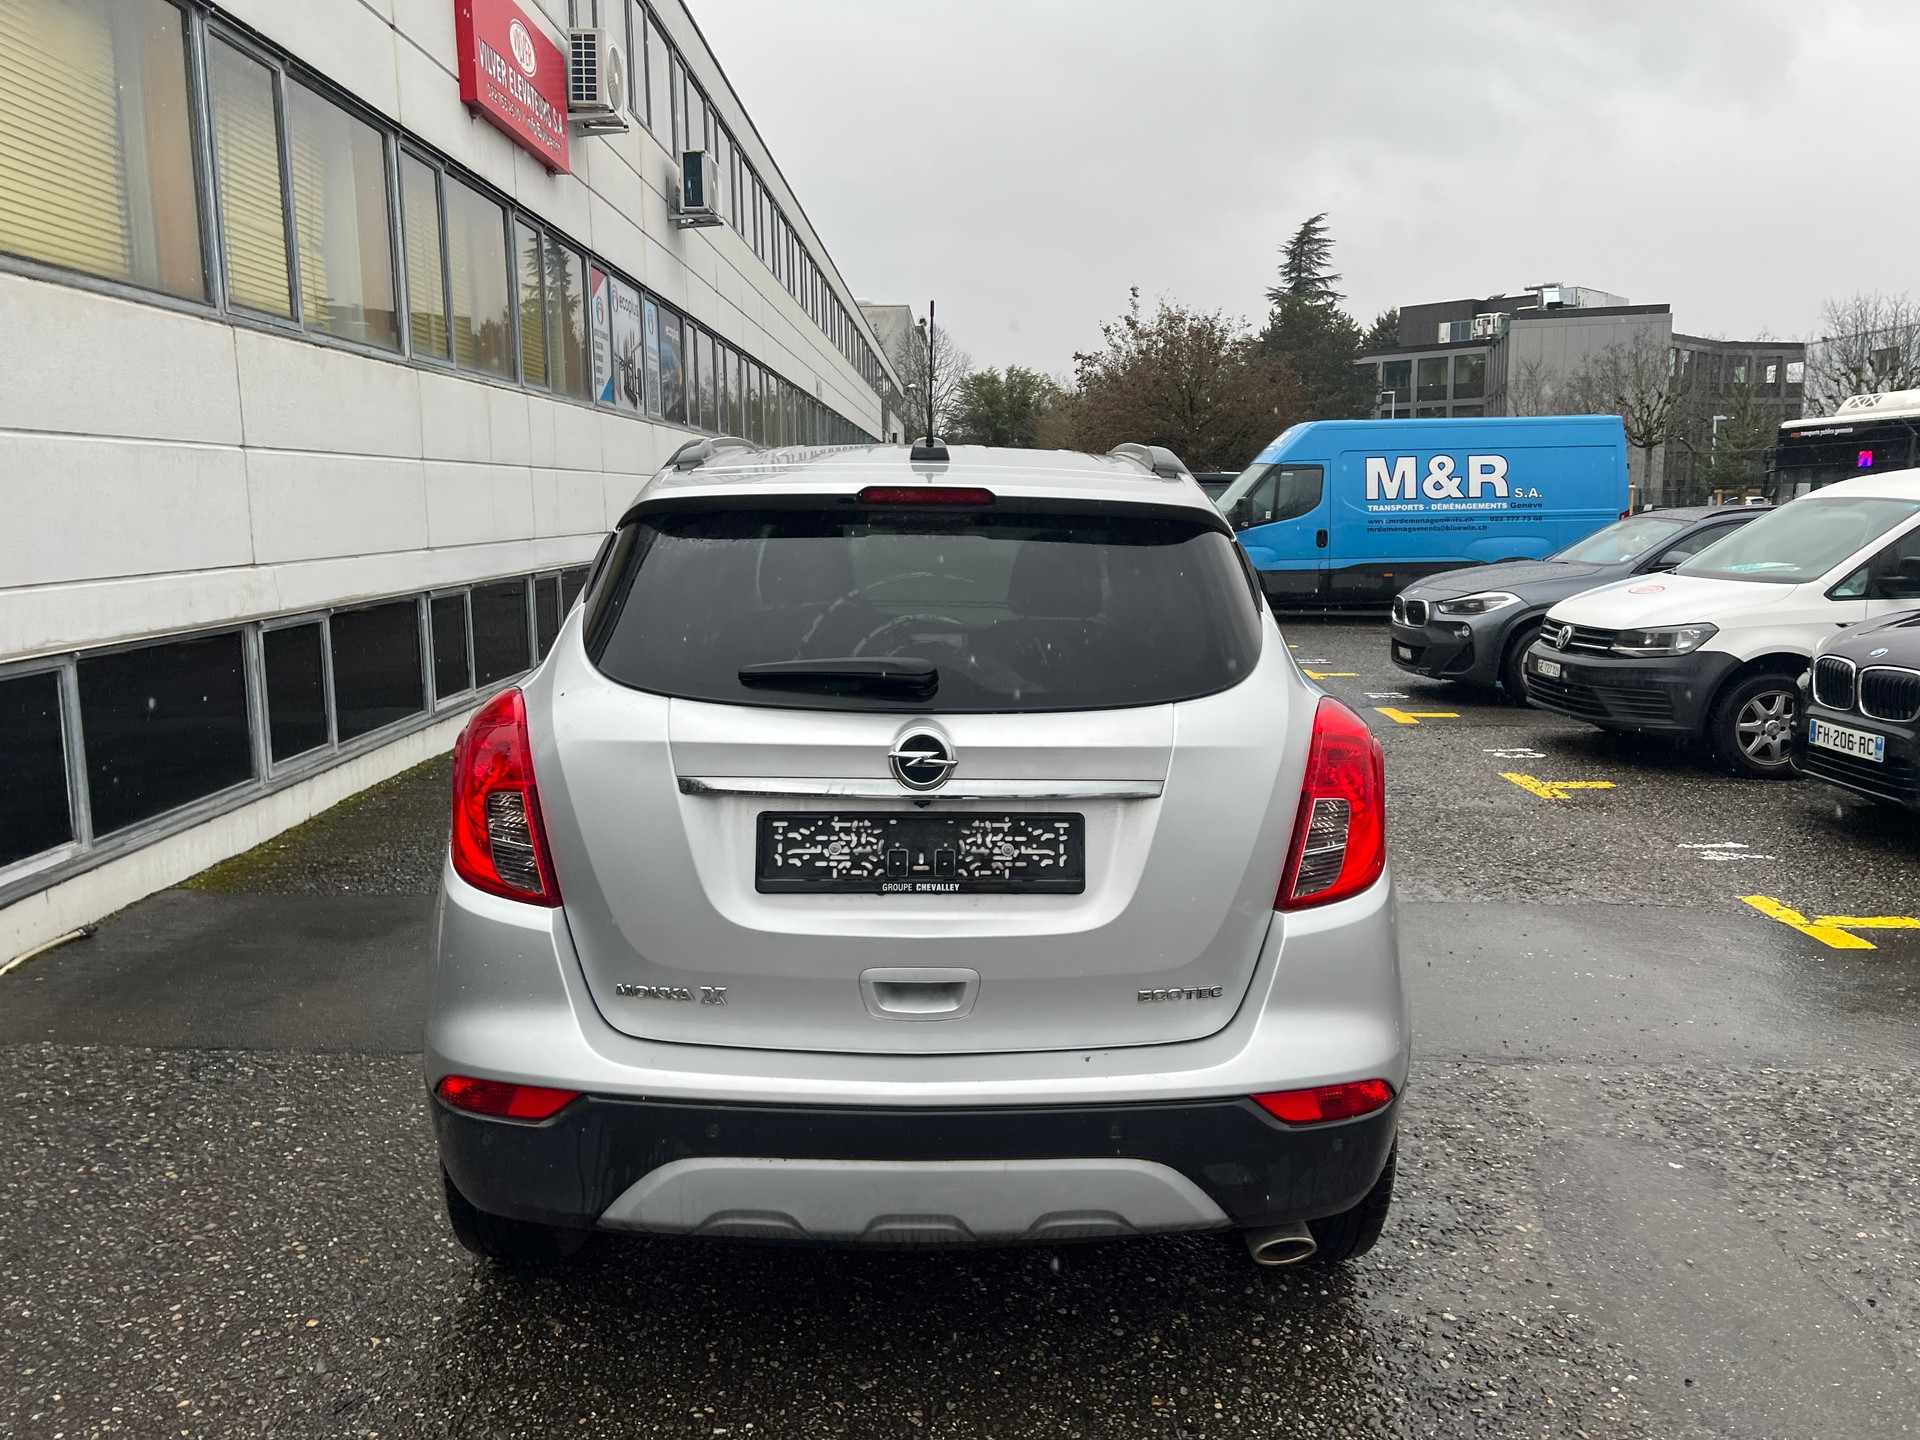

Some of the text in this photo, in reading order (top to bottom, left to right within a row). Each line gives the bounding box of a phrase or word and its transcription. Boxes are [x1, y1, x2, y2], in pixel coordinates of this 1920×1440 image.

[478, 35, 508, 89] VILVER
[619, 294, 639, 319] ecoplus
[1365, 454, 1543, 501] M&R S.A.
[1367, 504, 1425, 512] TRANSPORTS
[1431, 501, 1508, 511] DÉMÉNAGEMENTS
[1367, 524, 1487, 533] mrdemenagements@bluewin.ch
[1817, 724, 1875, 756] FH-206-RC
[882, 883, 960, 892] GROUPE CHEVALLEY
[615, 982, 729, 1006] MOKKA X
[1137, 984, 1224, 1002] ECOTEC
